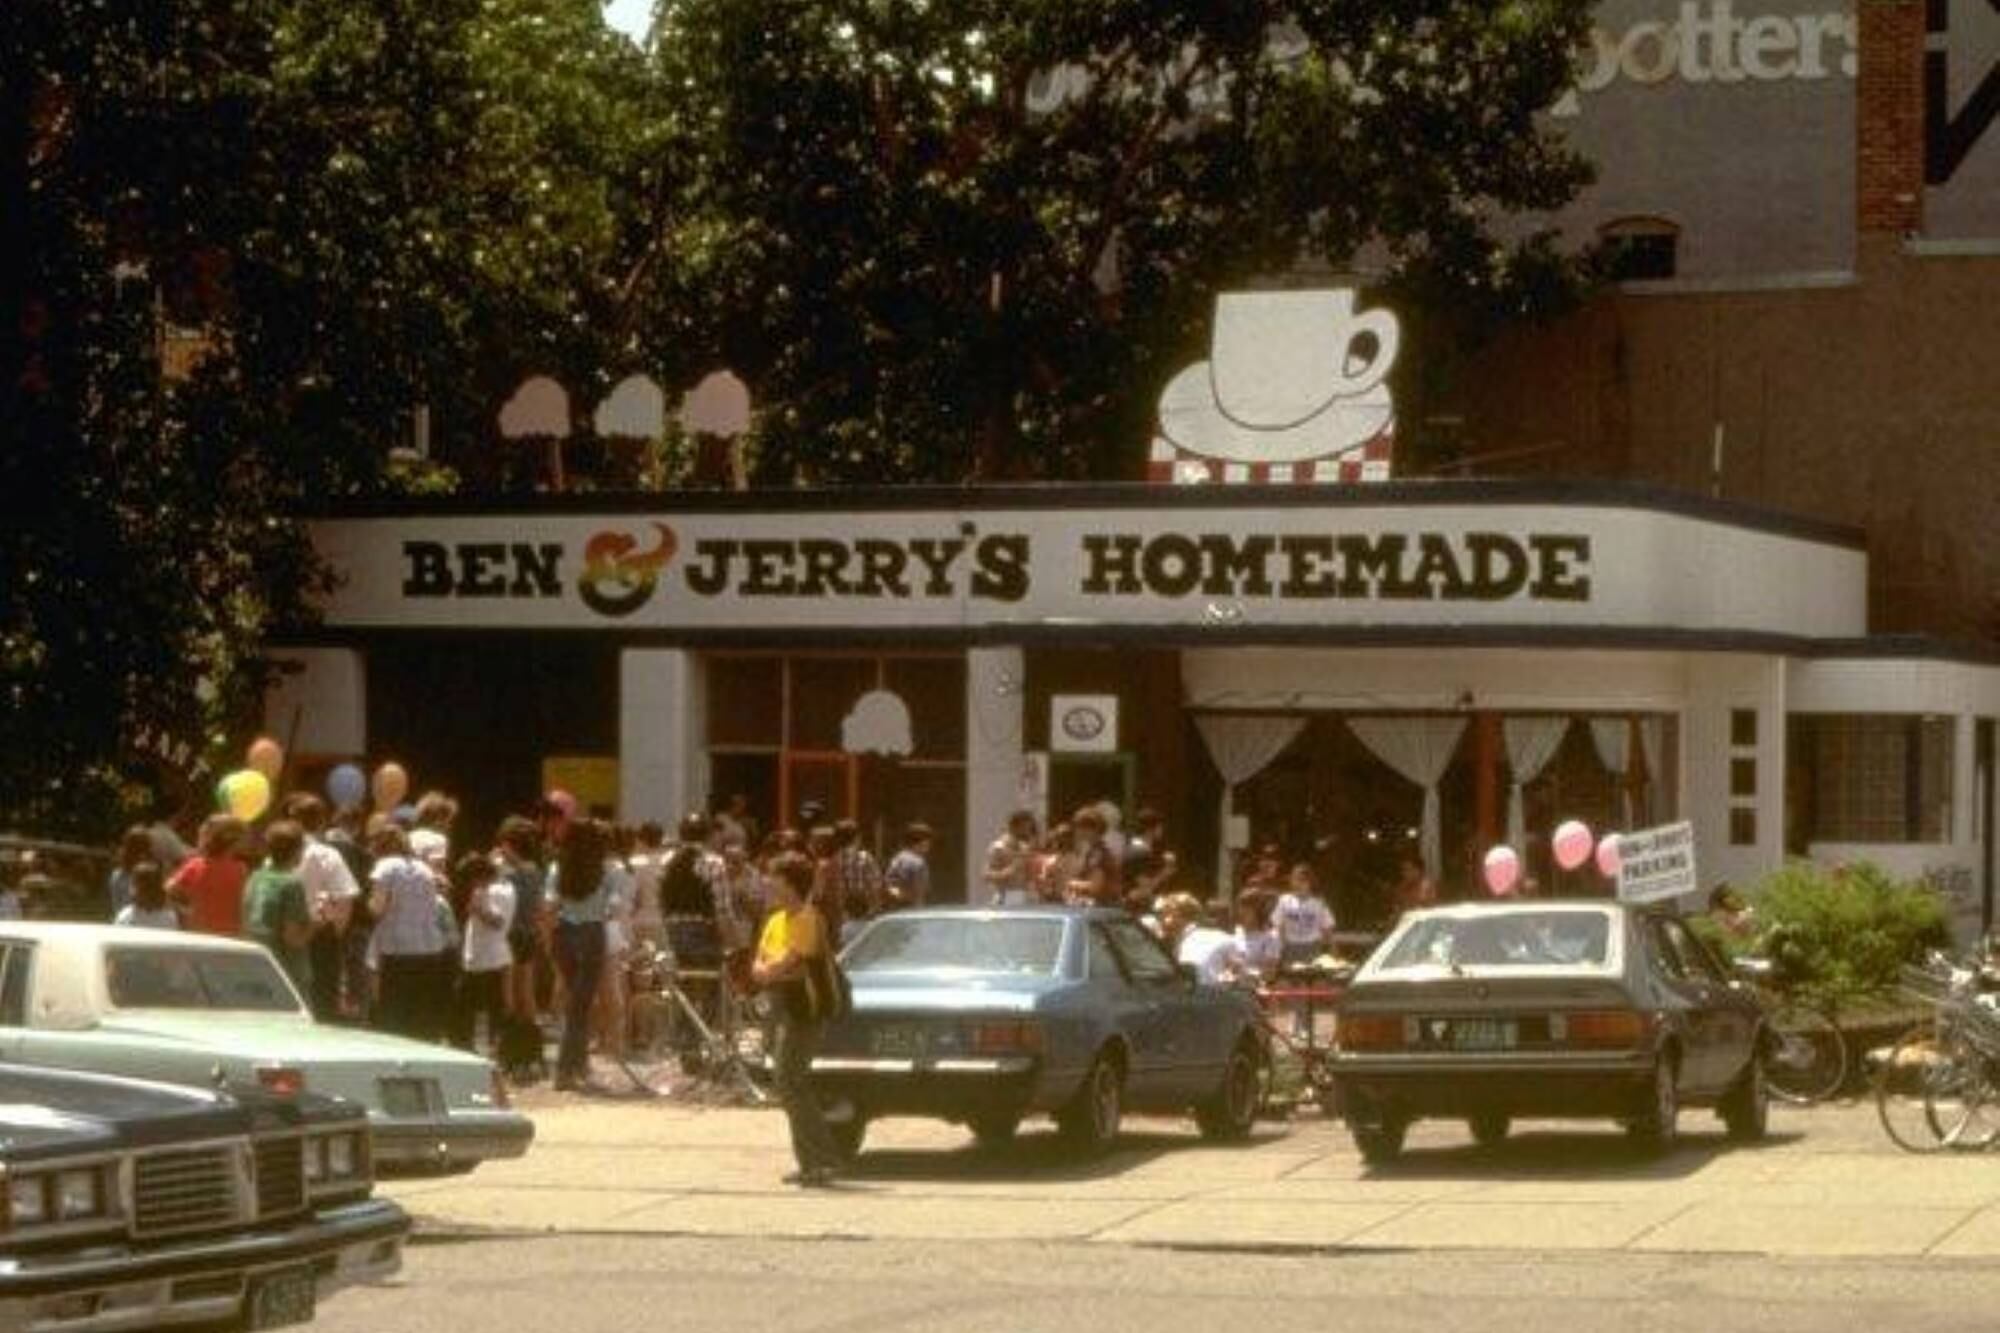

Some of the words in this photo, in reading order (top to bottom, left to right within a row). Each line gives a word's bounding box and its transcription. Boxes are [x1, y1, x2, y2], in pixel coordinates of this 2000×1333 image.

[402, 538, 564, 597] BEN
[578, 522, 679, 618] &
[685, 521, 1030, 603] JERRY'S
[1081, 533, 1592, 602] HOMEMADE
